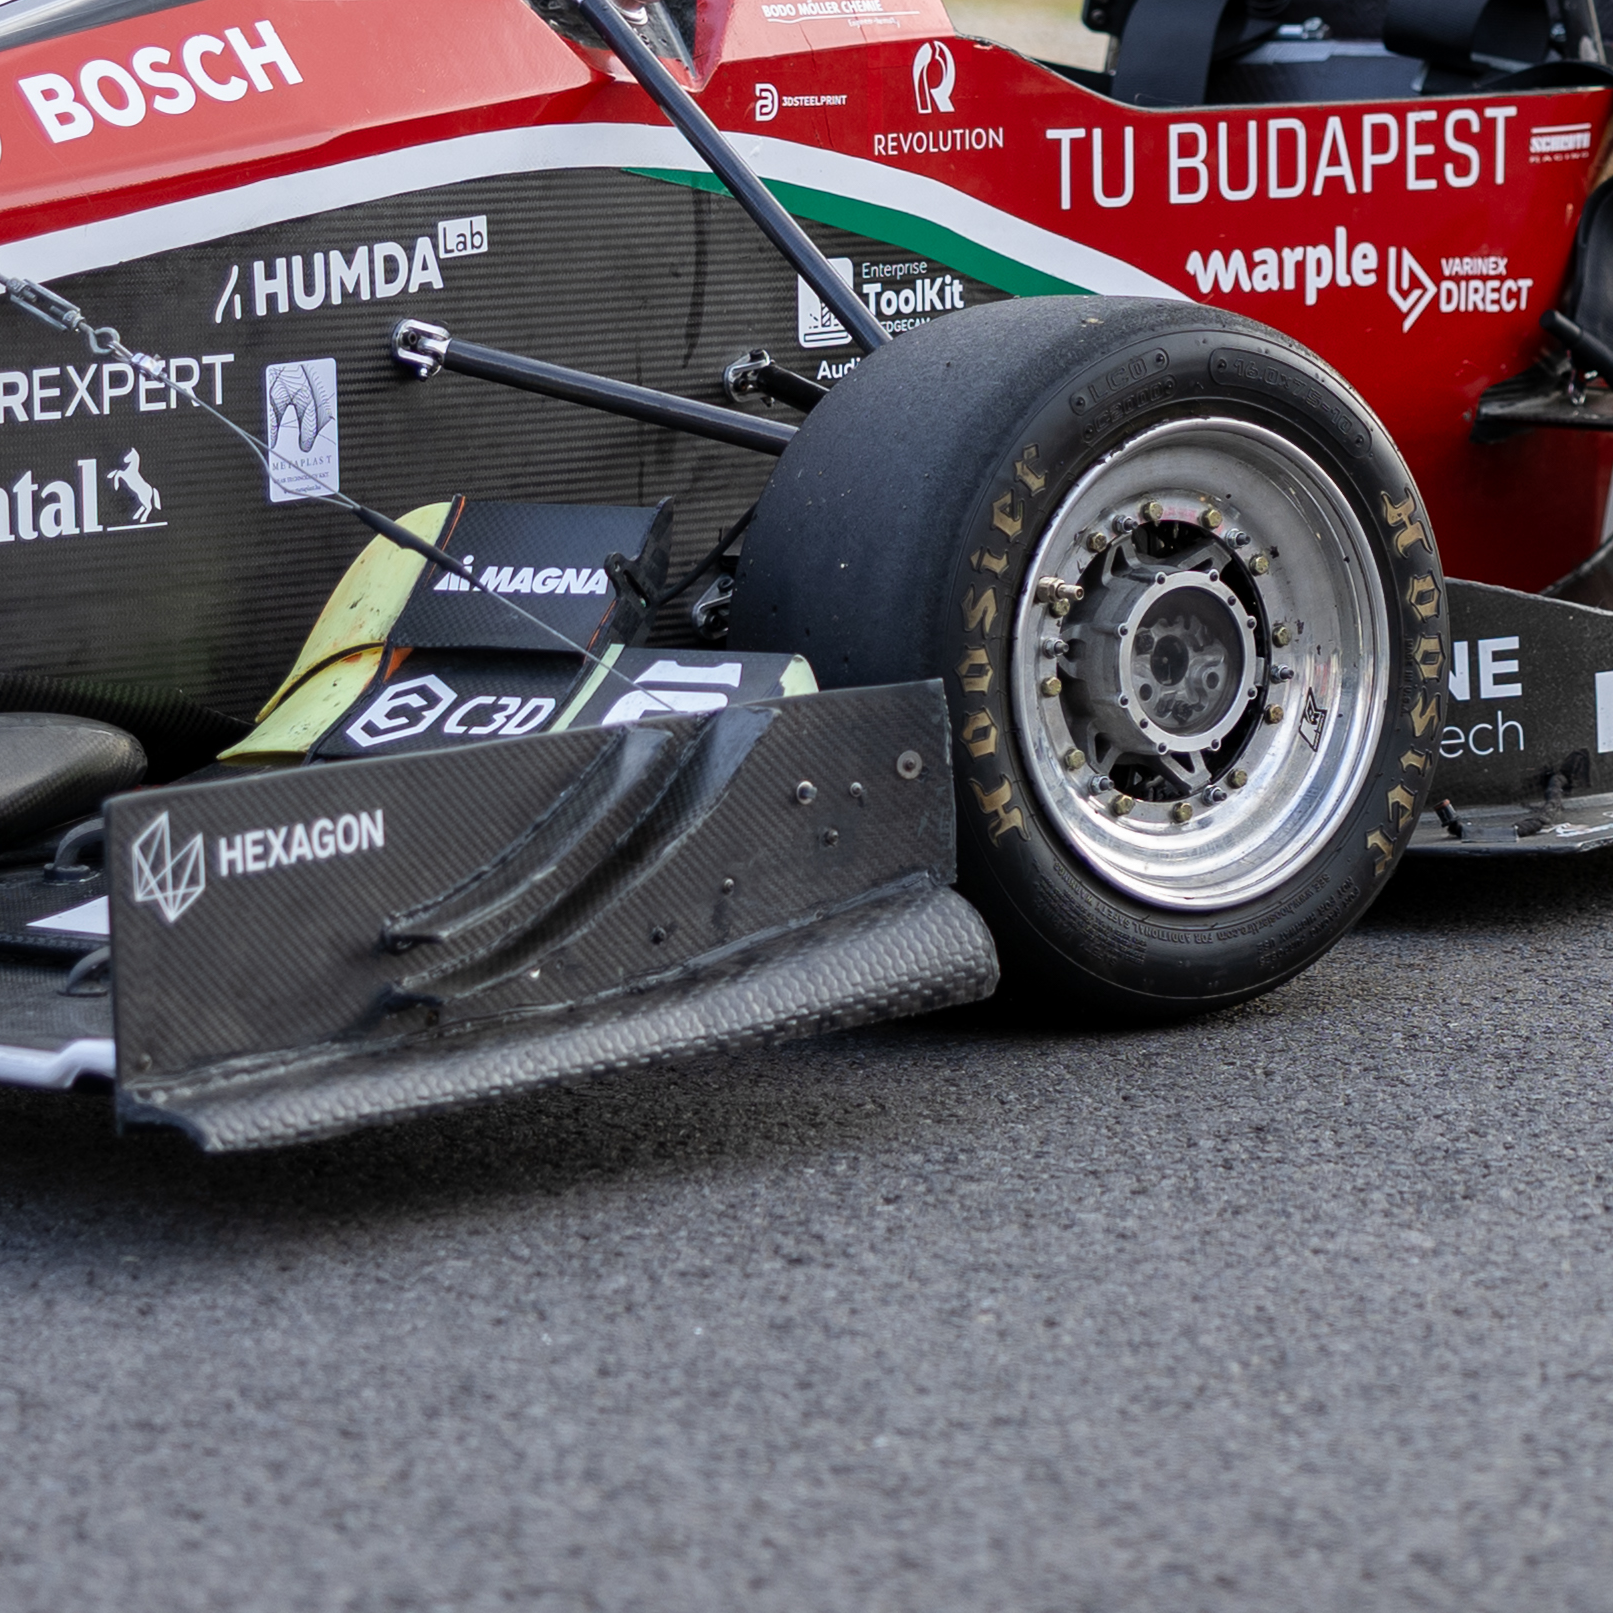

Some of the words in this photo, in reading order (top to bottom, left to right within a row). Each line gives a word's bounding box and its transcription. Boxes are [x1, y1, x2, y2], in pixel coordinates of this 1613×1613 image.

[761, 4, 796, 18] BODO
[797, 0, 840, 16] MÖLLER
[841, 0, 884, 13] CHEMIE
[18, 19, 304, 144] BOSCH
[782, 95, 848, 107] 3DSTEELPRINT
[873, 127, 1004, 156] REVOLUTION
[1045, 125, 1136, 210] TU
[1168, 105, 1518, 206] BUDAPEST
[253, 236, 444, 316] HUMDA
[442, 220, 484, 255] Lab
[861, 261, 928, 280] Enterprise
[1186, 225, 1379, 307] marple
[1440, 256, 1507, 277] VARINEX
[862, 274, 965, 316] ToolKit
[1439, 278, 1533, 314] DIRECT
[272, 455, 333, 471] METAPLAST
[477, 564, 609, 595] MAGNA
[443, 695, 556, 736] C3D
[1439, 710, 1524, 759] ech
[218, 806, 386, 878] HEXAGON
[1132, 921, 1192, 945] ADDITIONAL
